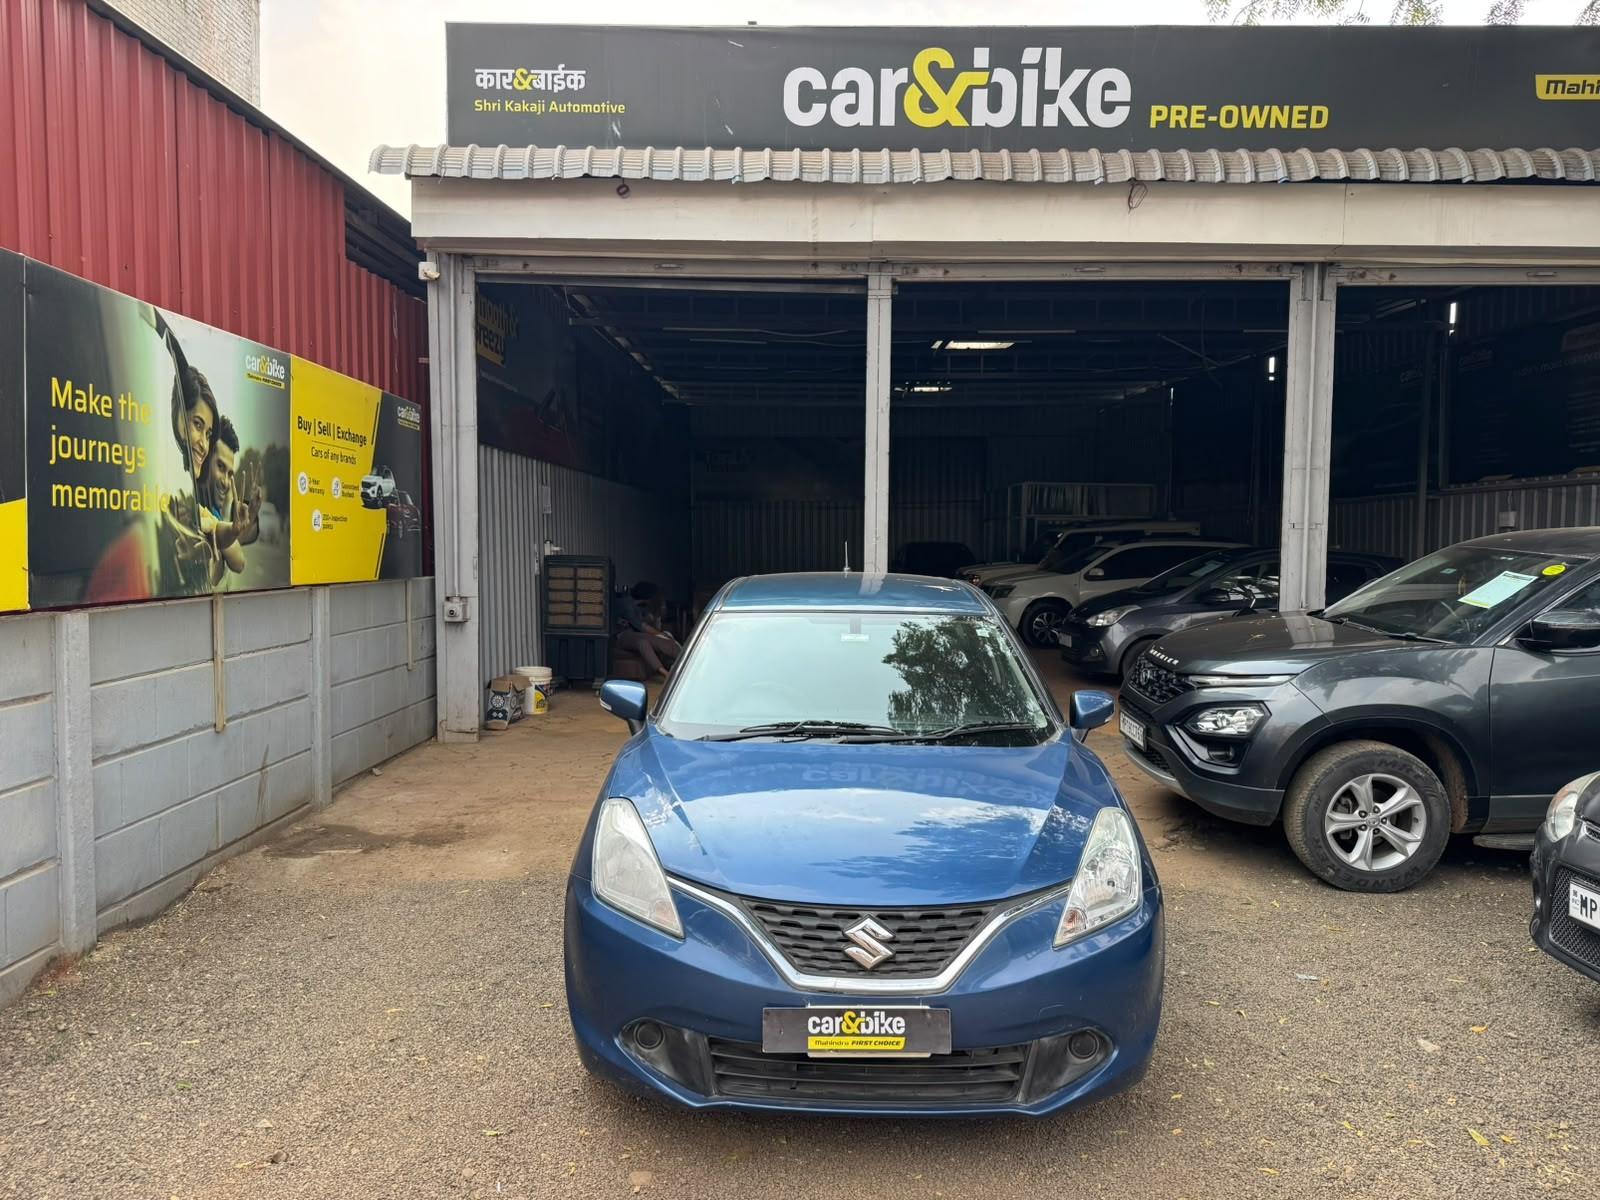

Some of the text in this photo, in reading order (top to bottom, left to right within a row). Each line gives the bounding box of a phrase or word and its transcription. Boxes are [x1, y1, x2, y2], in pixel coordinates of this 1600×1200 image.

[474, 64, 586, 93] कार&बाईक
[783, 47, 1132, 128] car&bike
[474, 99, 625, 115] Shri Kakaji Automotive
[1149, 104, 1329, 129] PRE-OWNED
[245, 355, 285, 380] car&bike
[51, 376, 152, 426] Make the
[297, 415, 312, 435] Buy
[317, 420, 332, 437] Sell
[336, 426, 368, 447] Exchange
[49, 424, 146, 473] journeys
[311, 446, 323, 459] Cars
[323, 449, 330, 460] of
[330, 452, 340, 463] any
[52, 482, 170, 513] memorable
[1580, 894, 1598, 921] MP
[807, 1010, 906, 1035] car&bike
[814, 1038, 850, 1046] Mahindra
